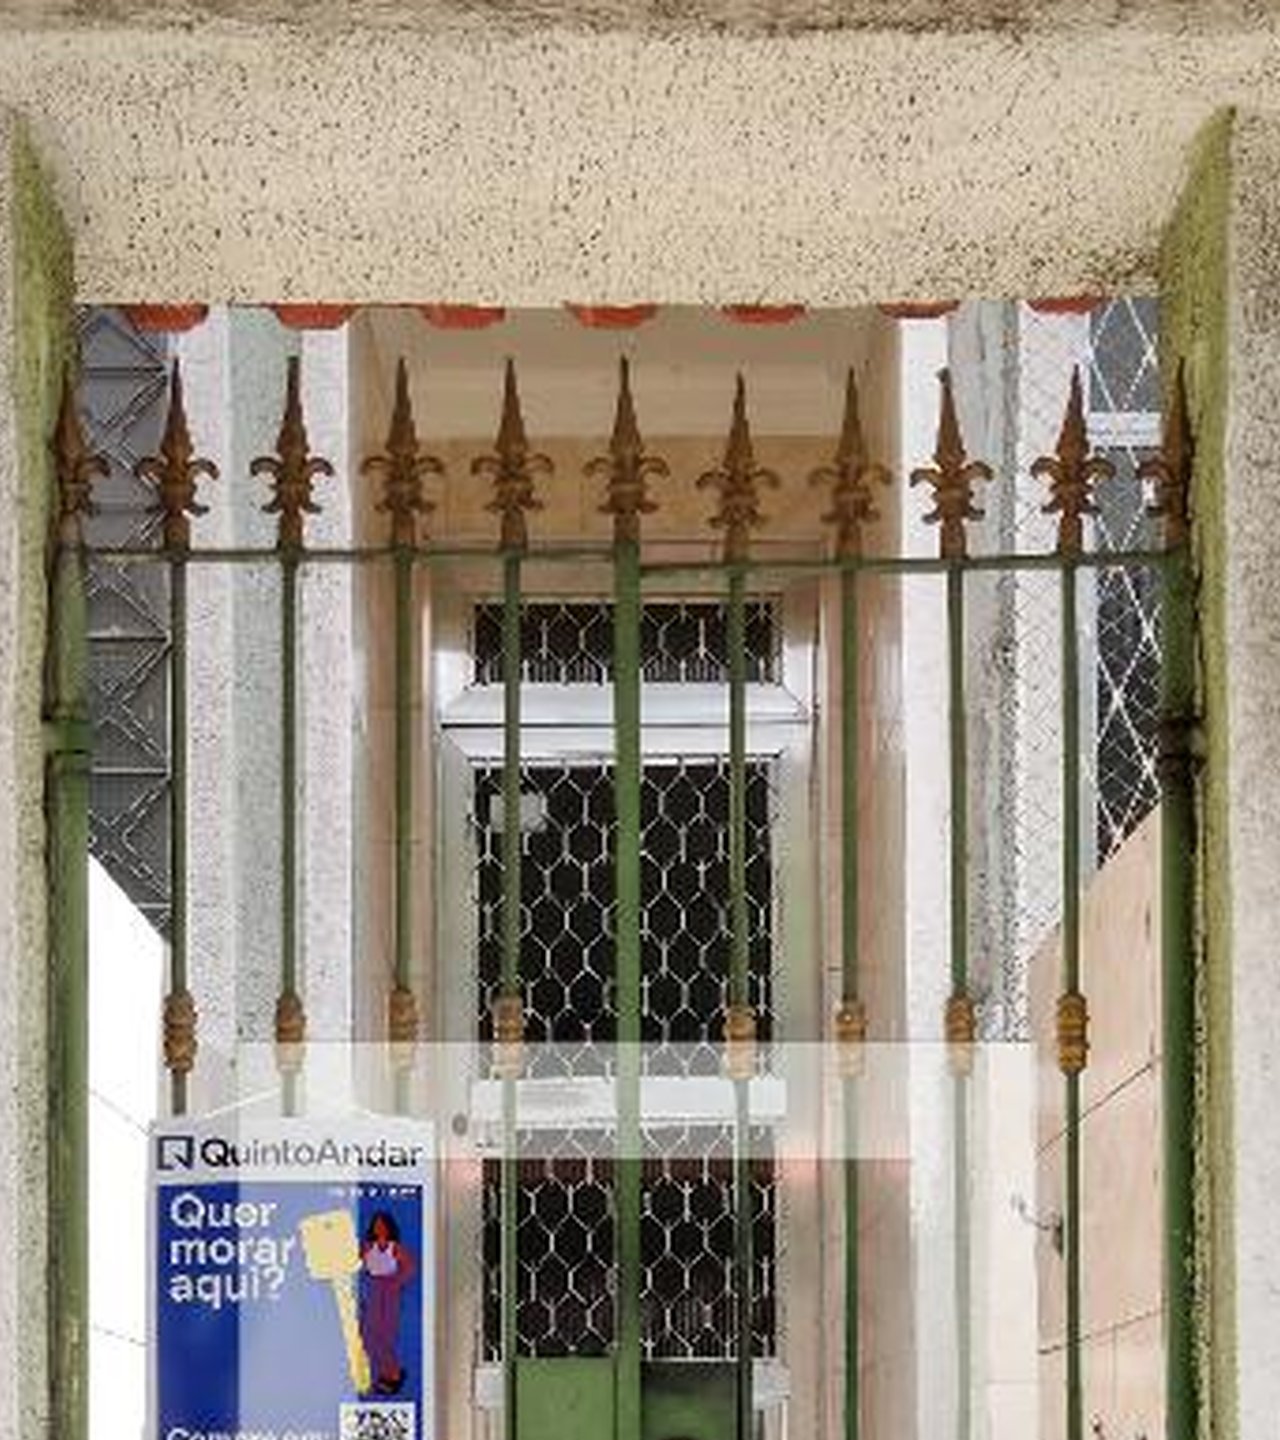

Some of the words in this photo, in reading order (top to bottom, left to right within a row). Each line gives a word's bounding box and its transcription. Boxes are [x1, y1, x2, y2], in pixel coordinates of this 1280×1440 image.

[200, 1138, 423, 1168] QuintoAndar
[169, 1192, 278, 1230] Quer
[169, 1237, 297, 1265] morar
[169, 1266, 286, 1310] aqui?
